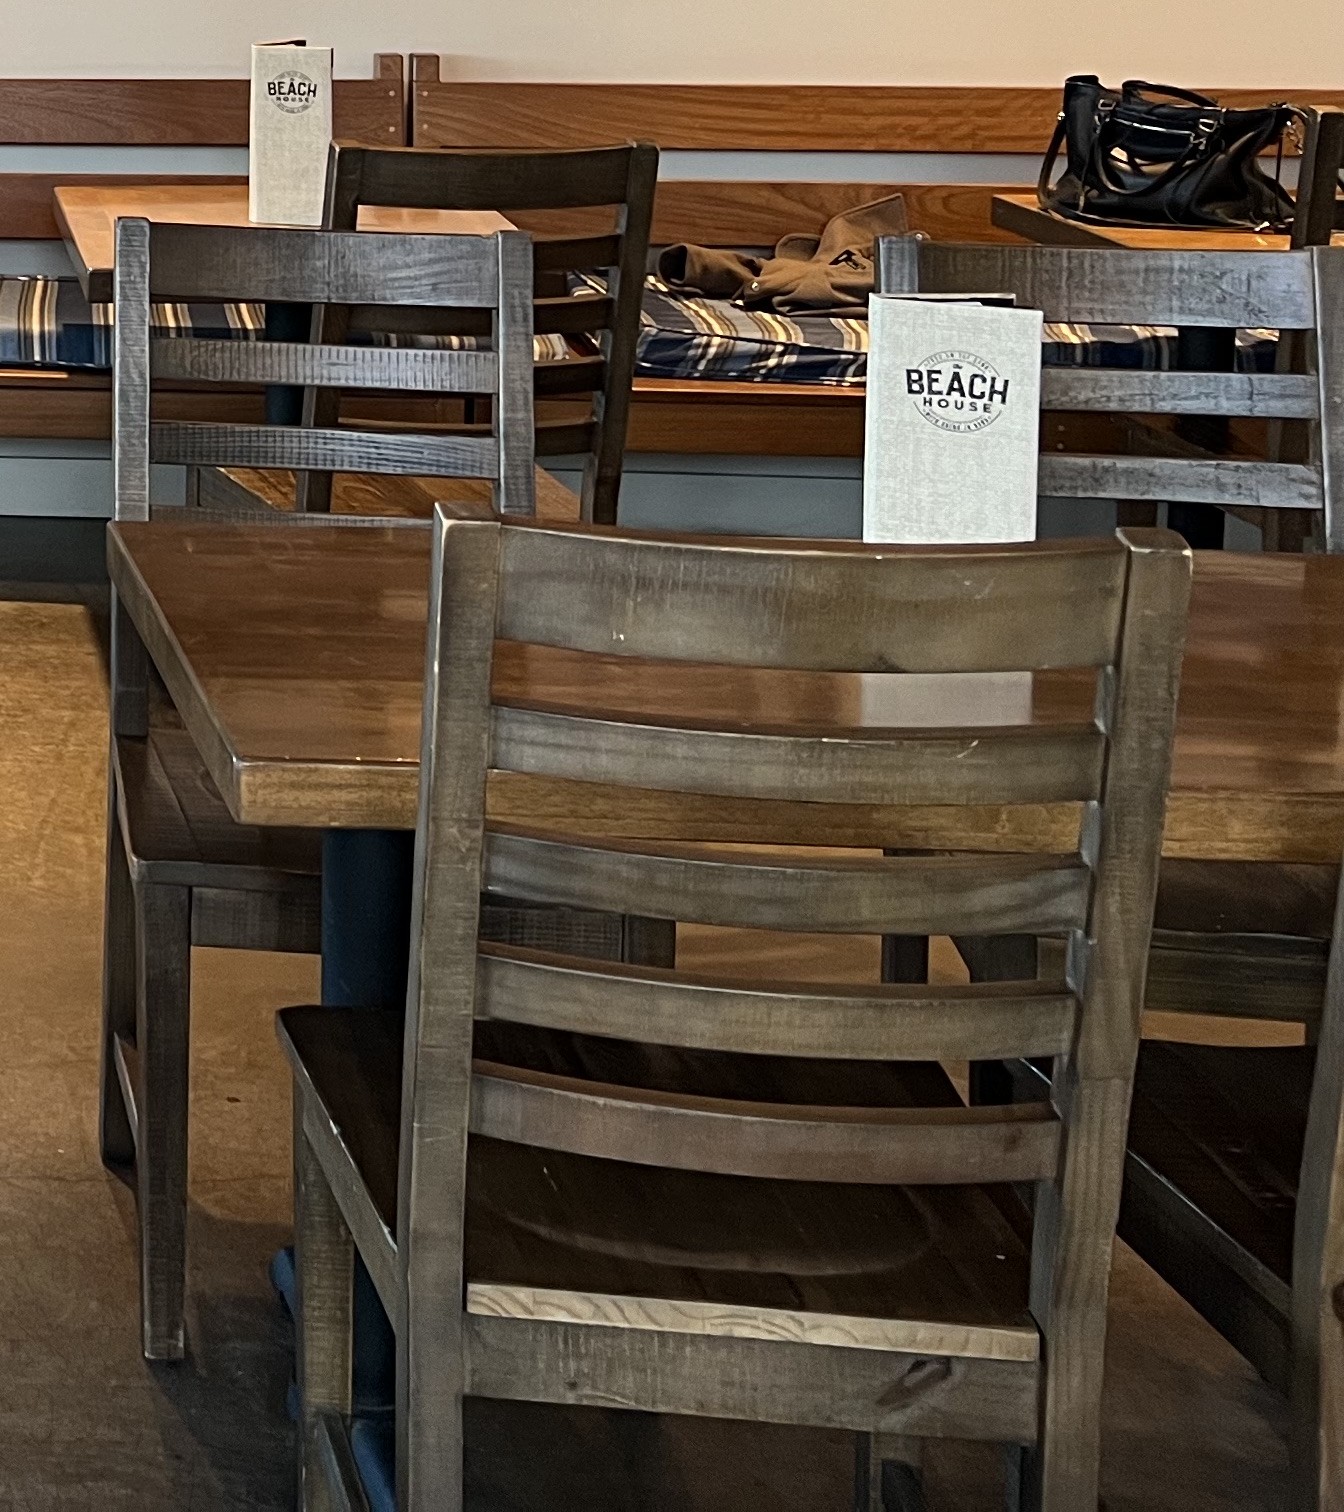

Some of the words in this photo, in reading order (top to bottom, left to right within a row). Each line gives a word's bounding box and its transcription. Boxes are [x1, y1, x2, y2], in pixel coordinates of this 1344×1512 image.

[267, 81, 317, 97] BEACH
[906, 368, 1010, 405] BEACH
[923, 397, 992, 413] HOUSE
